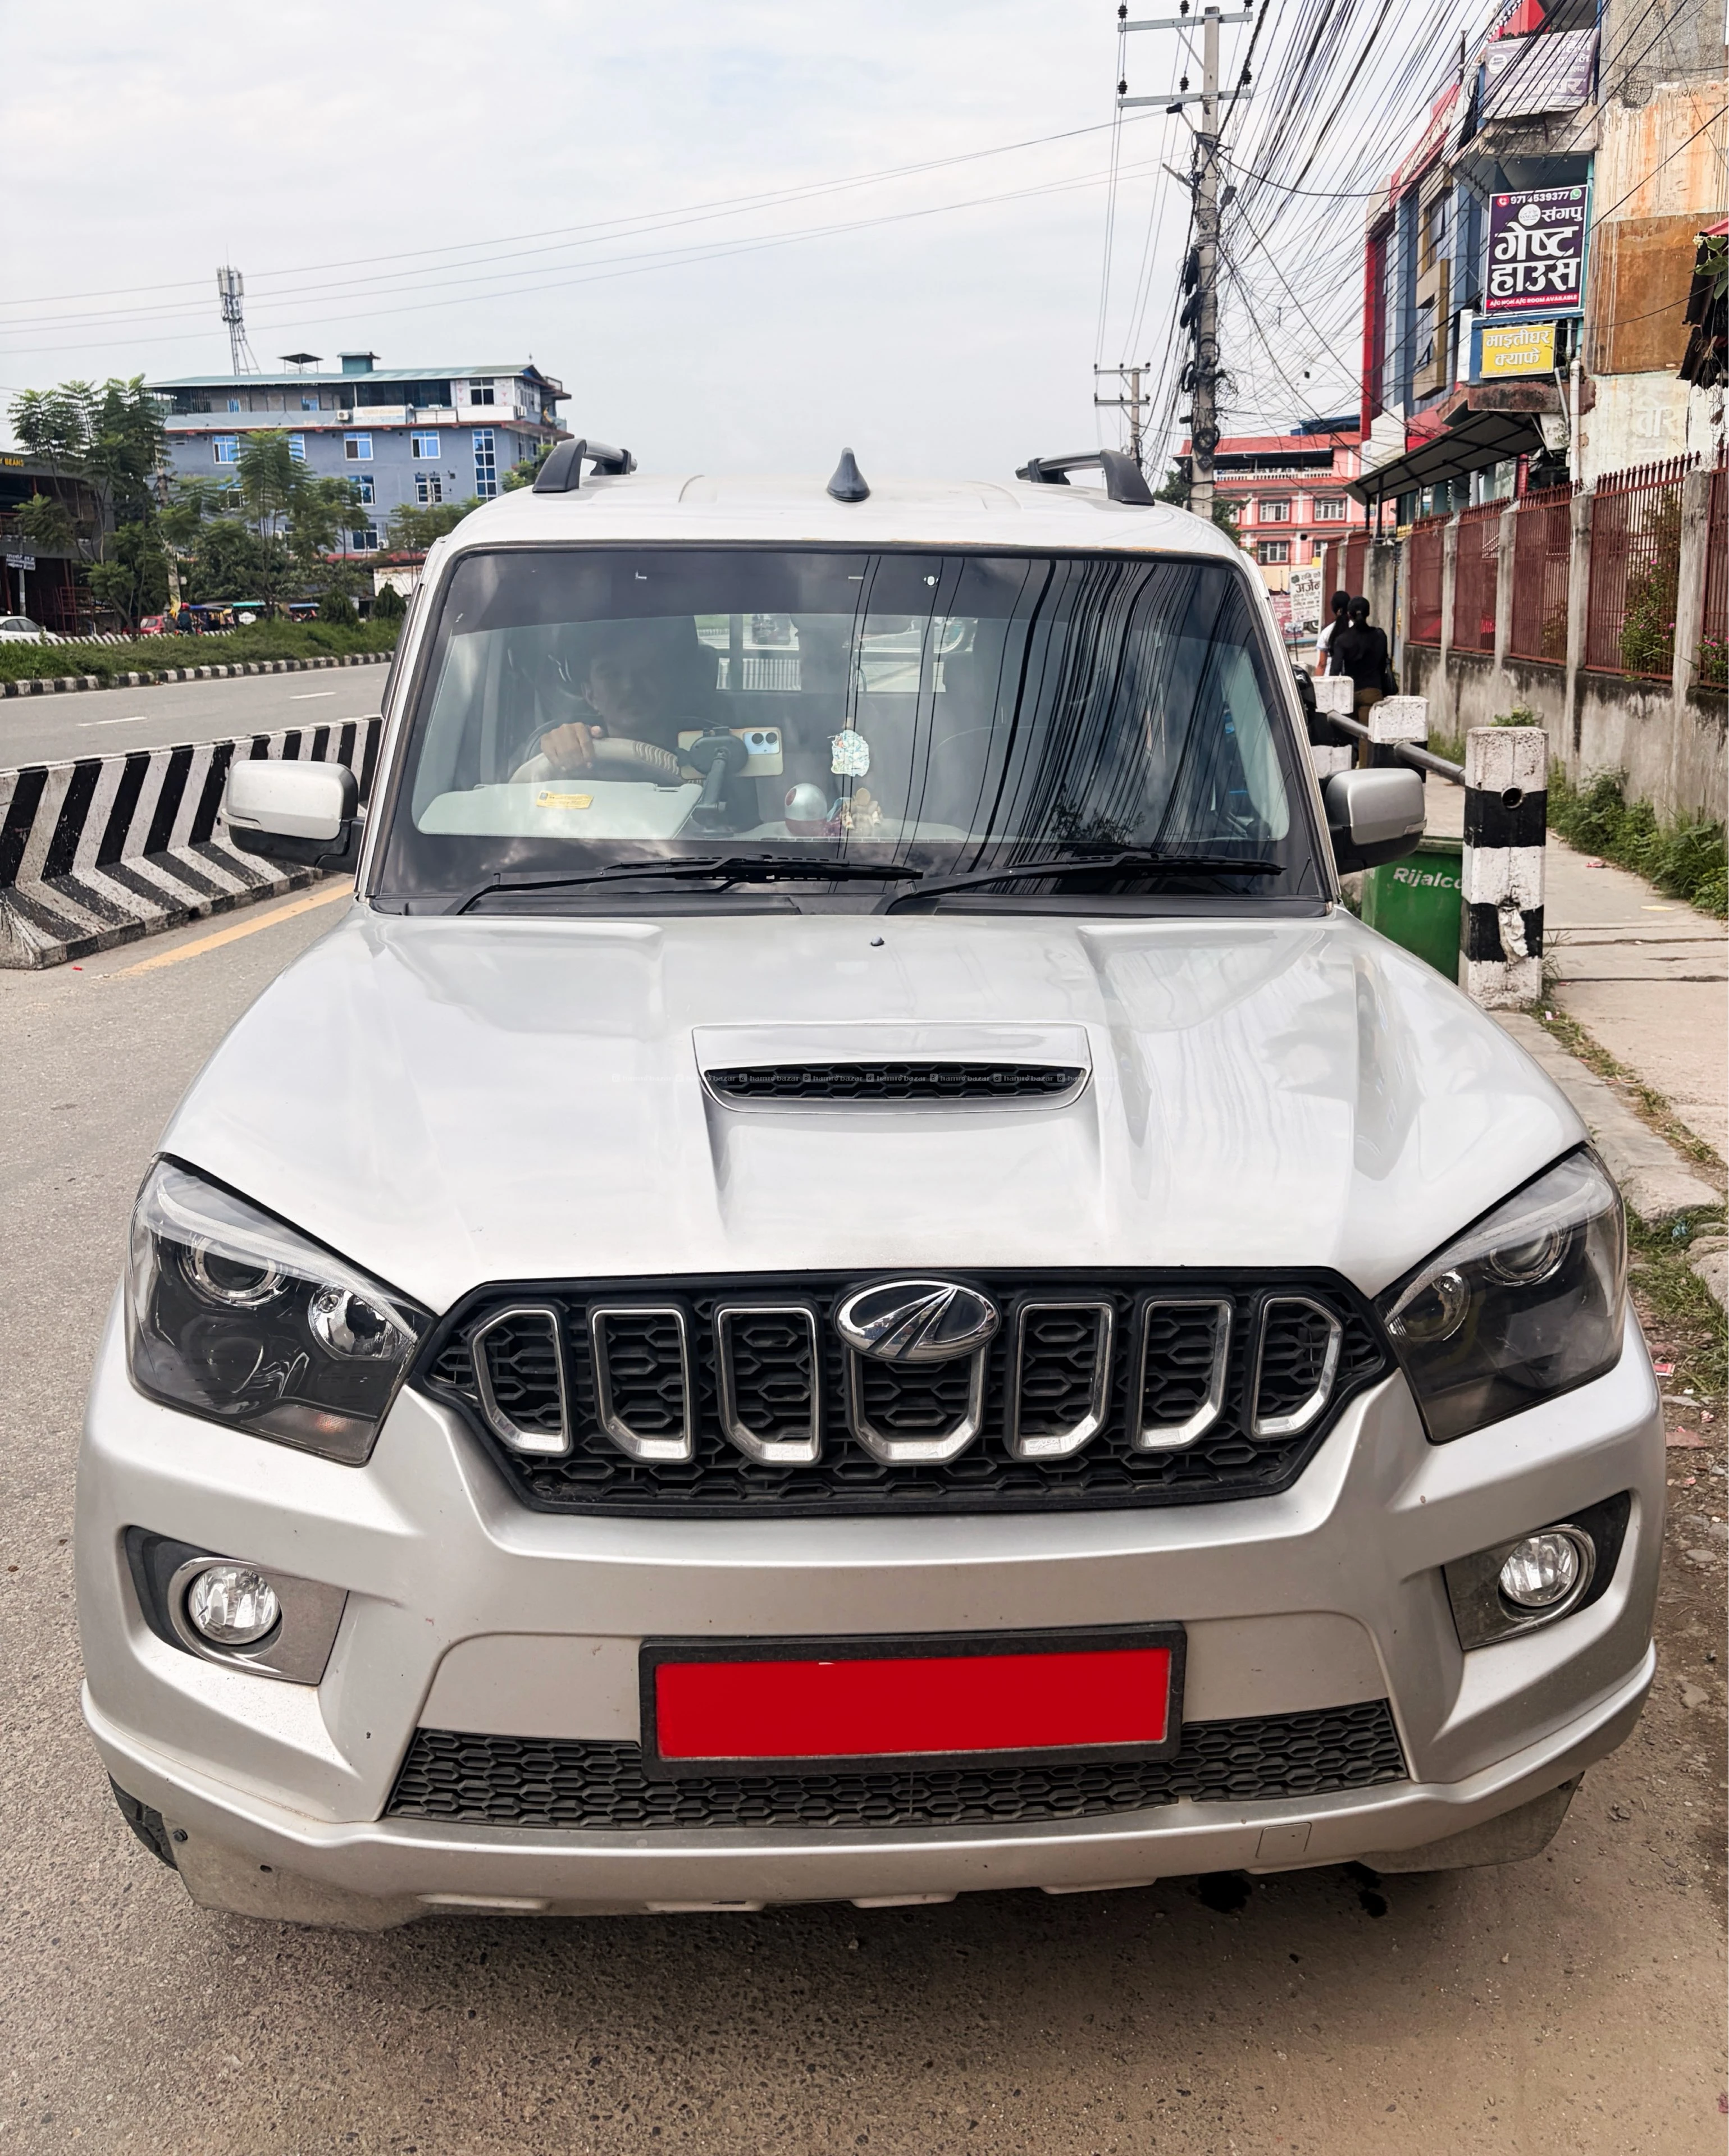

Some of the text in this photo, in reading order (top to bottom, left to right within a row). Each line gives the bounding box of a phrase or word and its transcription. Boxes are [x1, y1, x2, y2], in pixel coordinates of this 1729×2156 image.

[1541, 206, 1584, 222] संगपु
[1494, 221, 1580, 261] गेष्ट
[1490, 257, 1581, 297] हाउस
[1486, 328, 1552, 349] माइतीघर
[1495, 347, 1541, 366] क्याफे
